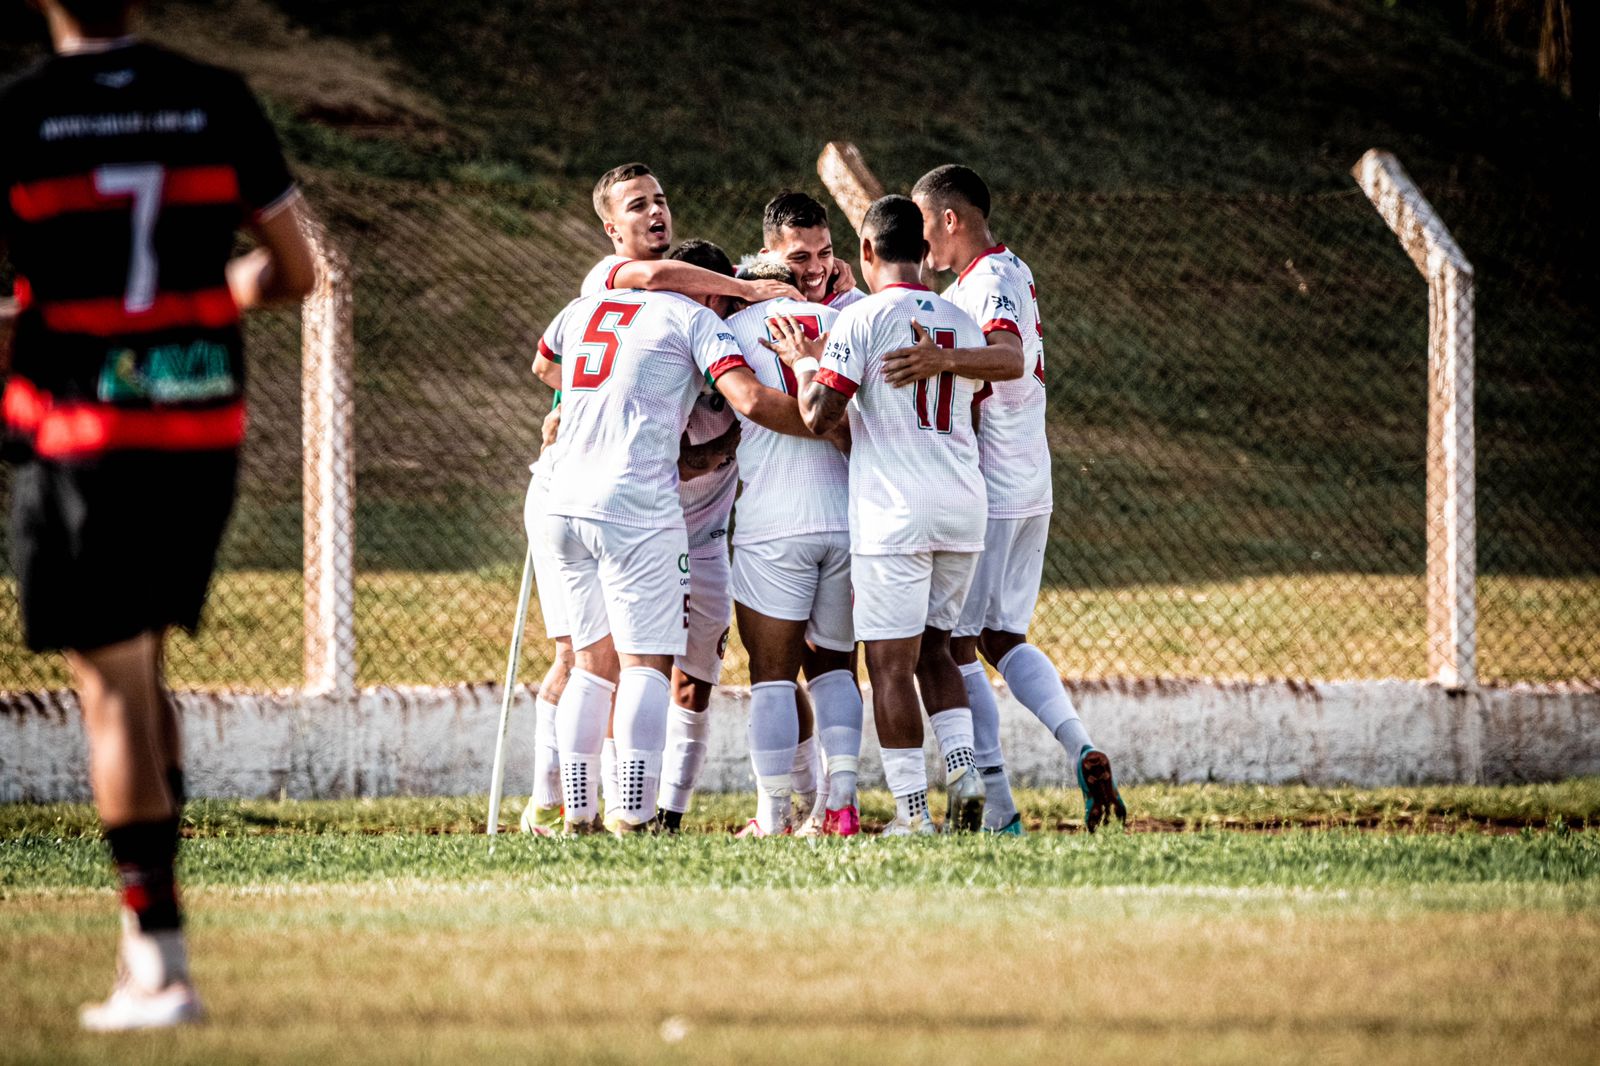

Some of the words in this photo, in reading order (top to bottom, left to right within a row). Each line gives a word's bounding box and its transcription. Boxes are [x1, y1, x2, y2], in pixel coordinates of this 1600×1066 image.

[94, 162, 164, 315] 7
[571, 299, 646, 392] 5
[824, 351, 849, 364] ard
[911, 325, 957, 434] 11
